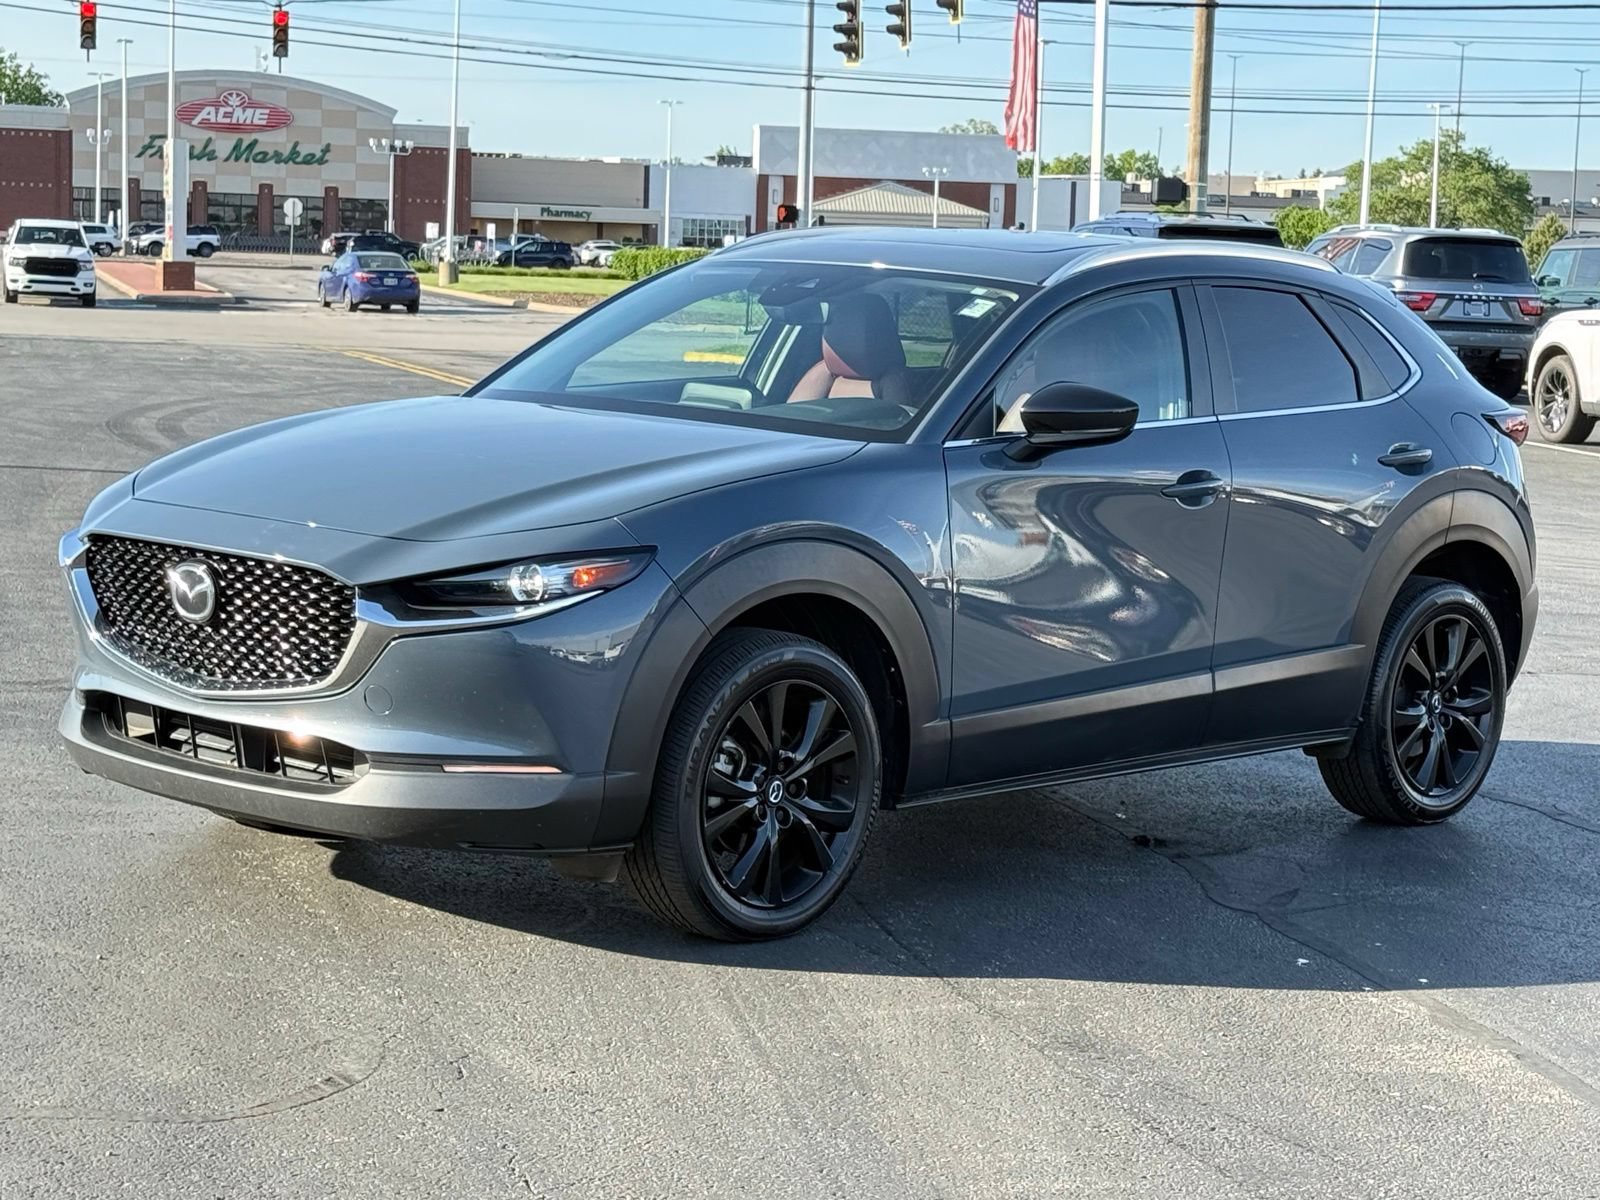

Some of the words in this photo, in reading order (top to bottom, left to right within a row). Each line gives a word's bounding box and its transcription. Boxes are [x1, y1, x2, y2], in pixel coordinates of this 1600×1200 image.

[191, 106, 270, 125] ACME
[223, 137, 331, 165] Market
[541, 206, 592, 221] Pharmacy
